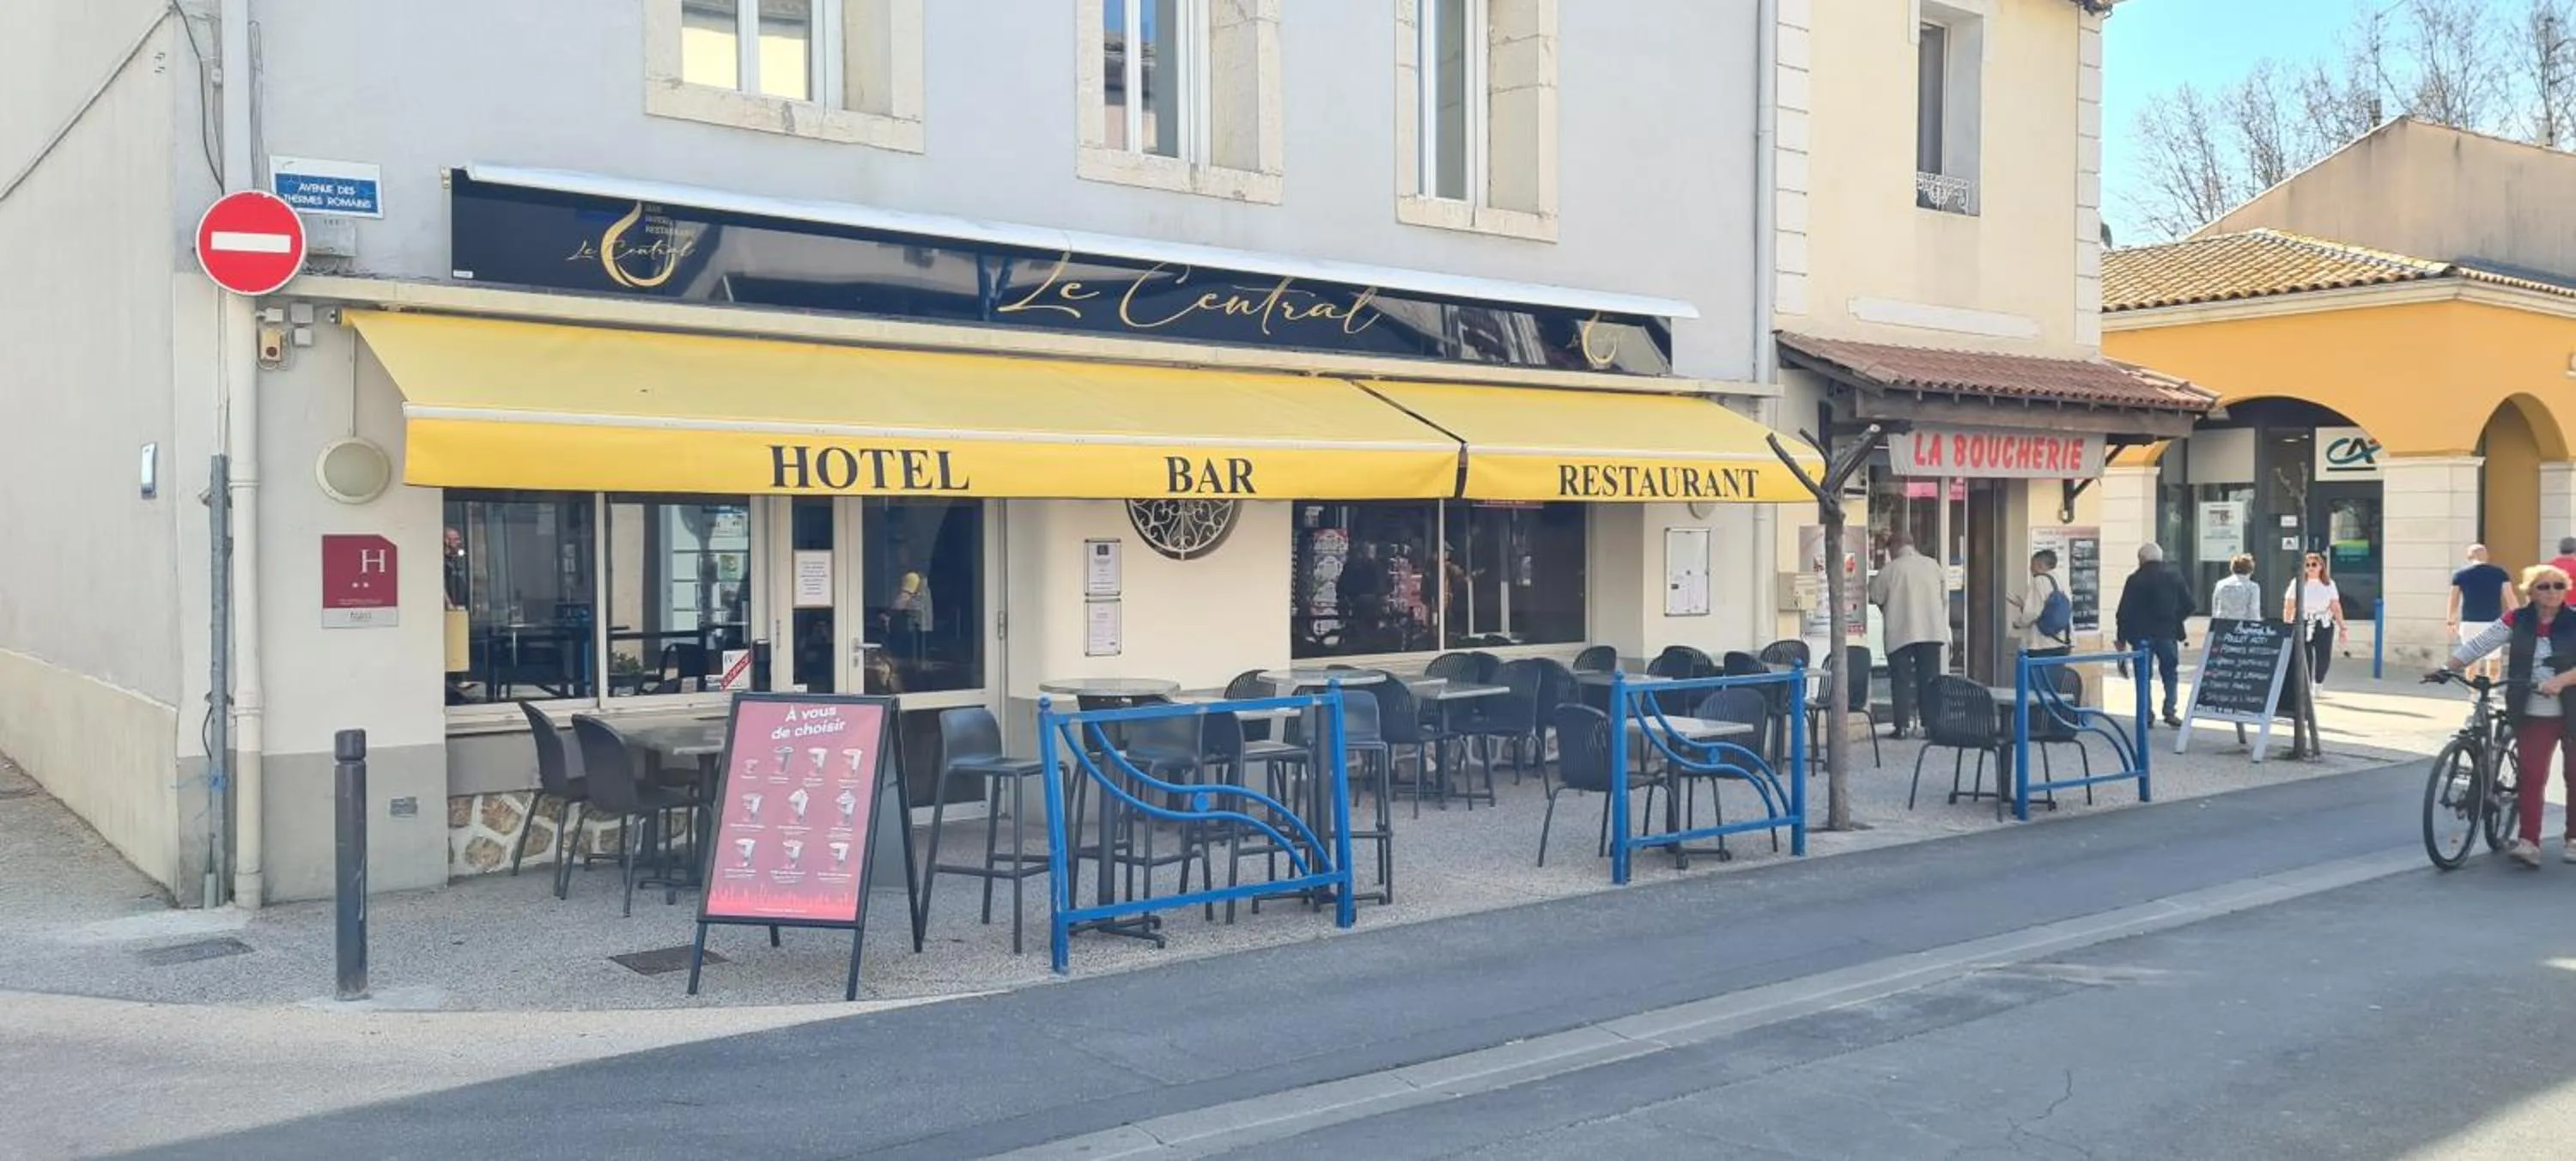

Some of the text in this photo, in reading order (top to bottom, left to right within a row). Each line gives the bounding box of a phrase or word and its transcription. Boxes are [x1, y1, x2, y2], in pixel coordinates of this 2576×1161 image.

[298, 182, 355, 196] AVENUE DES
[284, 193, 372, 209] THERMES ROMAINS
[566, 240, 598, 261] Le
[997, 240, 1381, 335] Le Central
[1914, 431, 2085, 472] LA BOUCHERIE
[766, 444, 1759, 499] HOTEL BAR RESTAURANT
[360, 549, 386, 573] H
[802, 707, 837, 720] vous
[771, 718, 846, 739] de choisir
